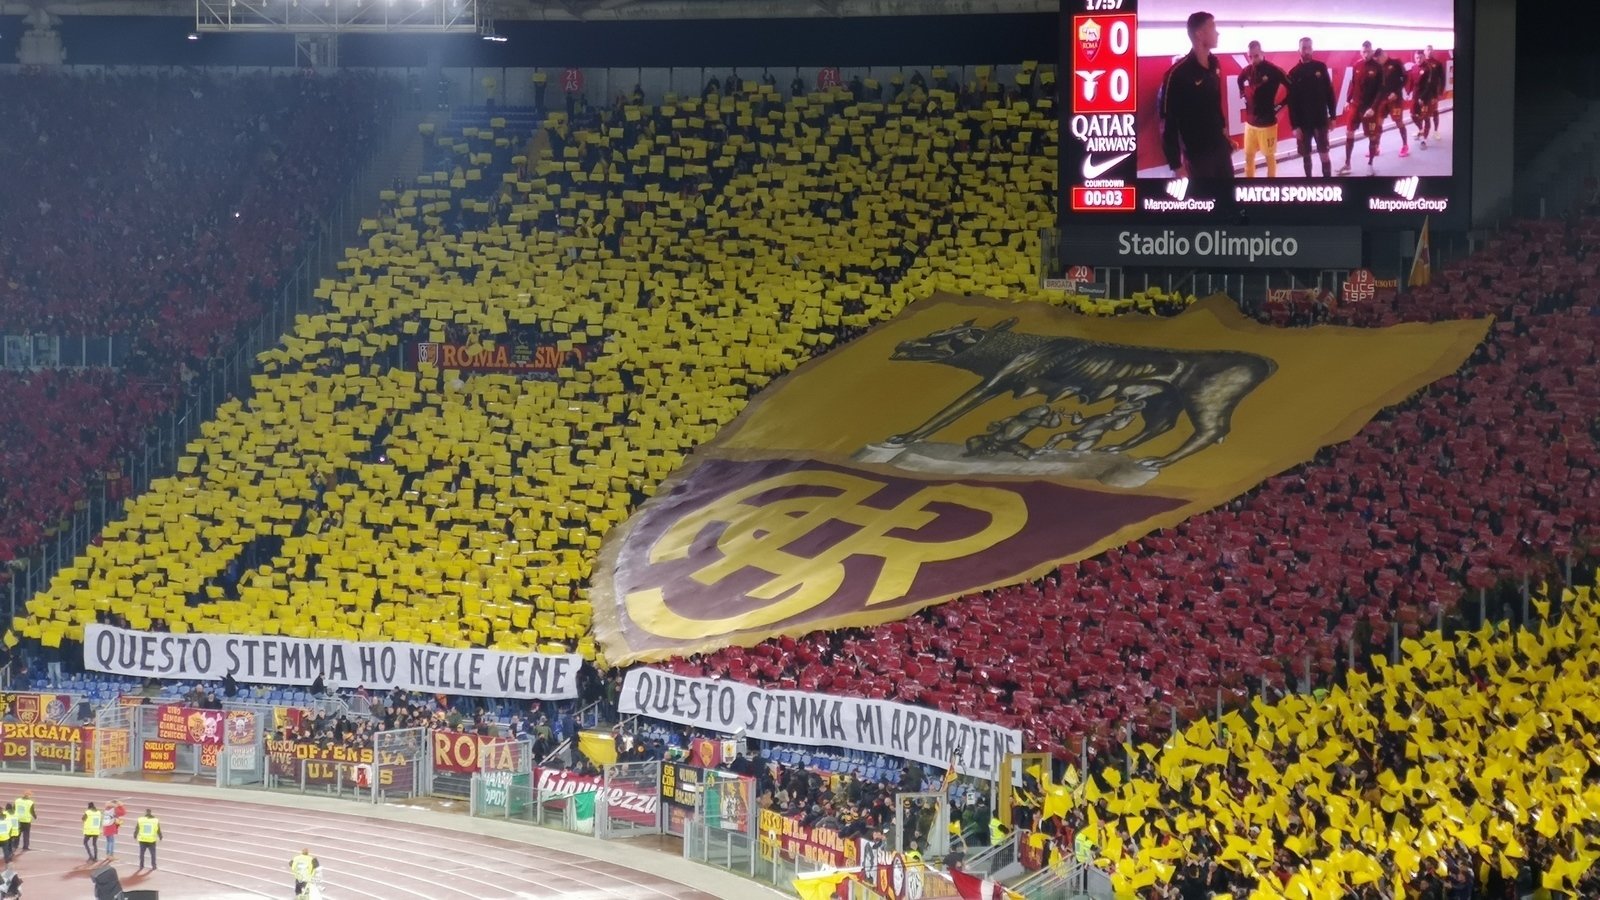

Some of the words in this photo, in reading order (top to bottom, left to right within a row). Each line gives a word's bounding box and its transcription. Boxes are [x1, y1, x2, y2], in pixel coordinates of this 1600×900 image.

[1110, 21, 1129, 54] 0
[1110, 68, 1129, 101] 0
[1072, 115, 1135, 141] QATAR
[1086, 137, 1136, 151] AIRWAYS
[1084, 179, 1125, 188] COUNTDOWN
[1084, 190, 1123, 206] 00:03
[1235, 186, 1281, 202] MATCH
[1281, 186, 1343, 202] SPONSOR
[1144, 199, 1216, 212] ManpowerGroup
[1369, 198, 1448, 212] ManpowerGroup
[1118, 231, 1190, 257] Stadio
[1194, 231, 1298, 262] Olimpico
[1075, 265, 1088, 278] 20
[1356, 270, 1368, 282] 19
[96, 630, 212, 674] QUESTO
[225, 638, 347, 682] STEMMA
[359, 646, 396, 684] HO
[410, 648, 485, 691] NELLE
[497, 654, 570, 695] VENE
[635, 671, 736, 725] QUESTO
[745, 693, 846, 741] STEMMA
[856, 703, 884, 746] MI
[4, 723, 82, 743] BRIGATA
[4, 742, 27, 757] De
[297, 744, 407, 766] OFFENSVA
[435, 733, 515, 772] ROMA
